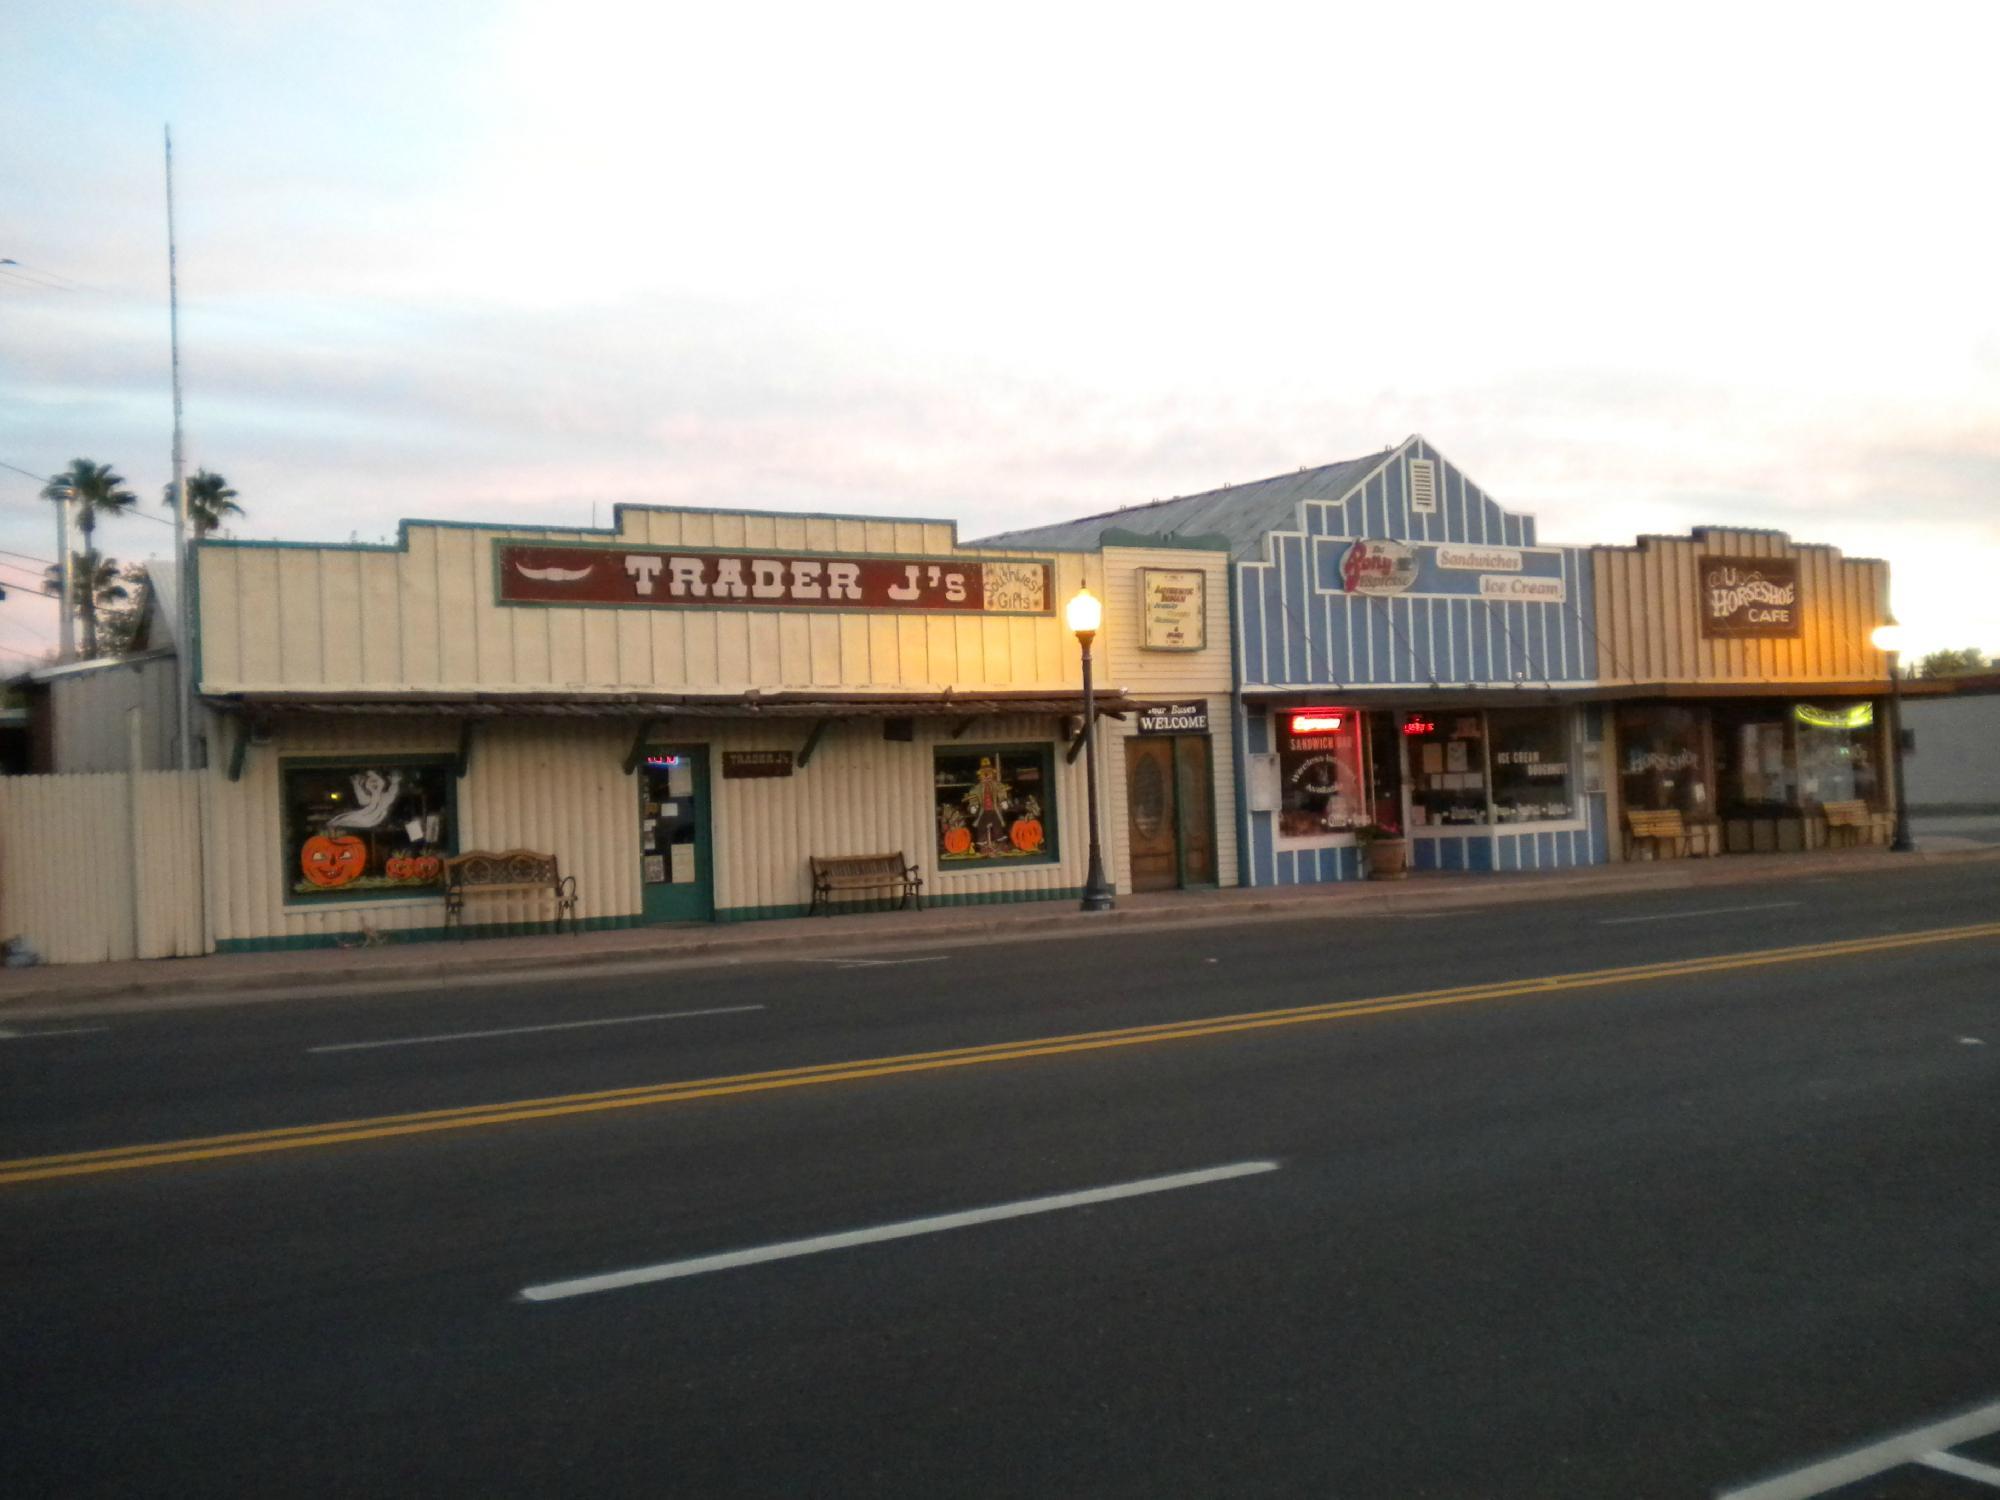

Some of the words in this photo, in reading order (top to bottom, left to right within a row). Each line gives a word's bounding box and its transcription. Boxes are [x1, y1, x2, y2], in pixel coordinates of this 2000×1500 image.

[1440, 550, 1519, 569] Sandwiches
[624, 555, 863, 600] TRADER
[1485, 579, 1505, 594] Ice
[1511, 579, 1560, 595] Cream
[998, 591, 1031, 609] Gifts
[1711, 580, 1795, 617] HORSESHOE
[1748, 609, 1789, 623] CAFE
[1141, 715, 1206, 730] WELCOME
[1290, 737, 1334, 751] SANDWICH
[729, 754, 773, 764] TRADER
